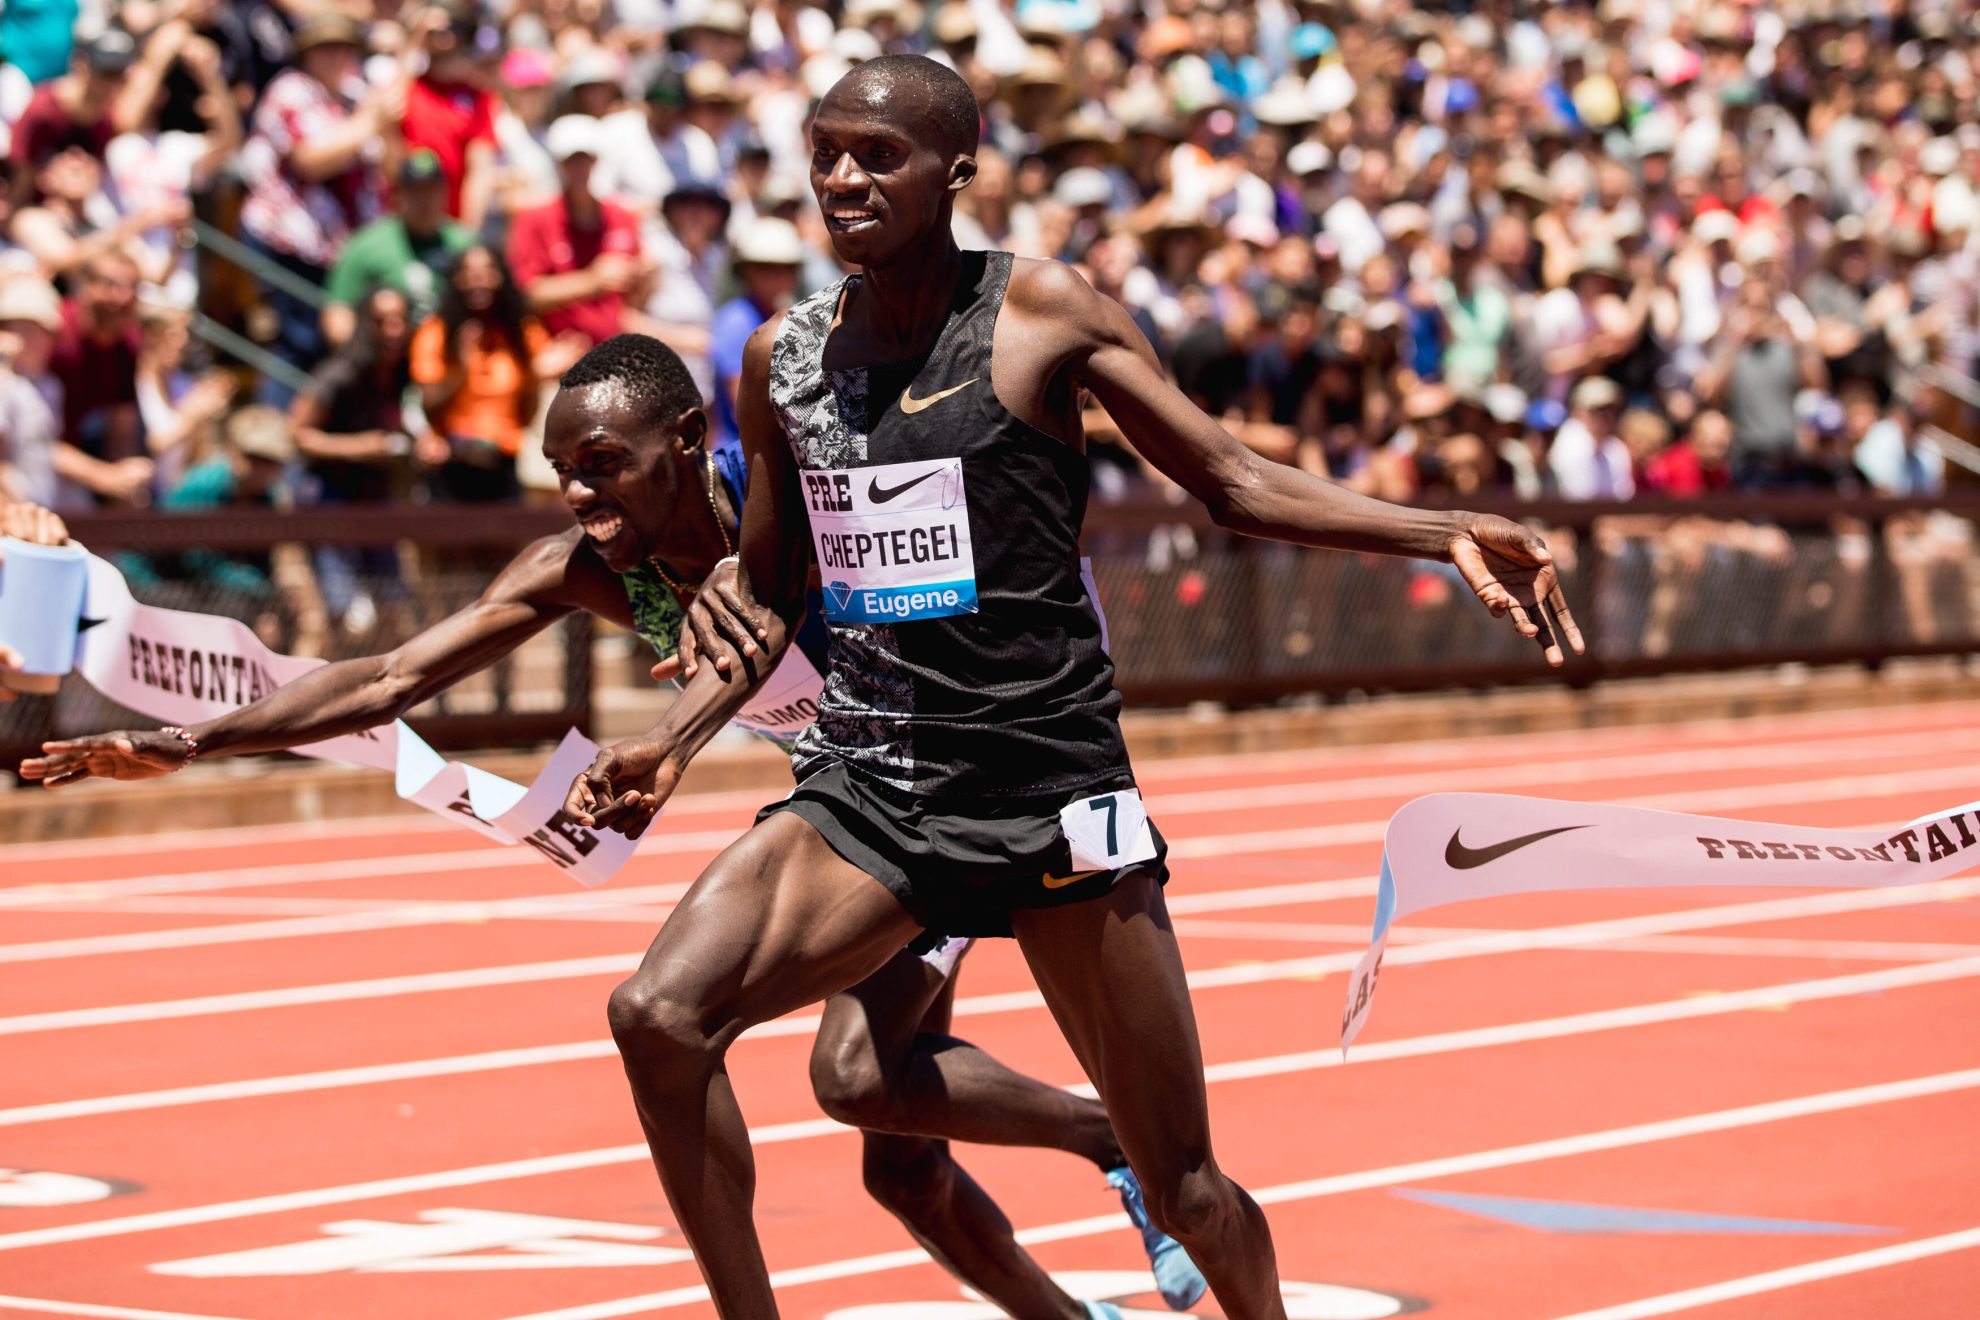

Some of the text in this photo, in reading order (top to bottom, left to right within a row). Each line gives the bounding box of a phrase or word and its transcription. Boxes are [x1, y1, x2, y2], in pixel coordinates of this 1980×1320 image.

[806, 474, 853, 511] PRE
[820, 524, 959, 568] CHEPTEGEI
[863, 588, 959, 617] Eugene
[1088, 794, 1119, 857] 7
